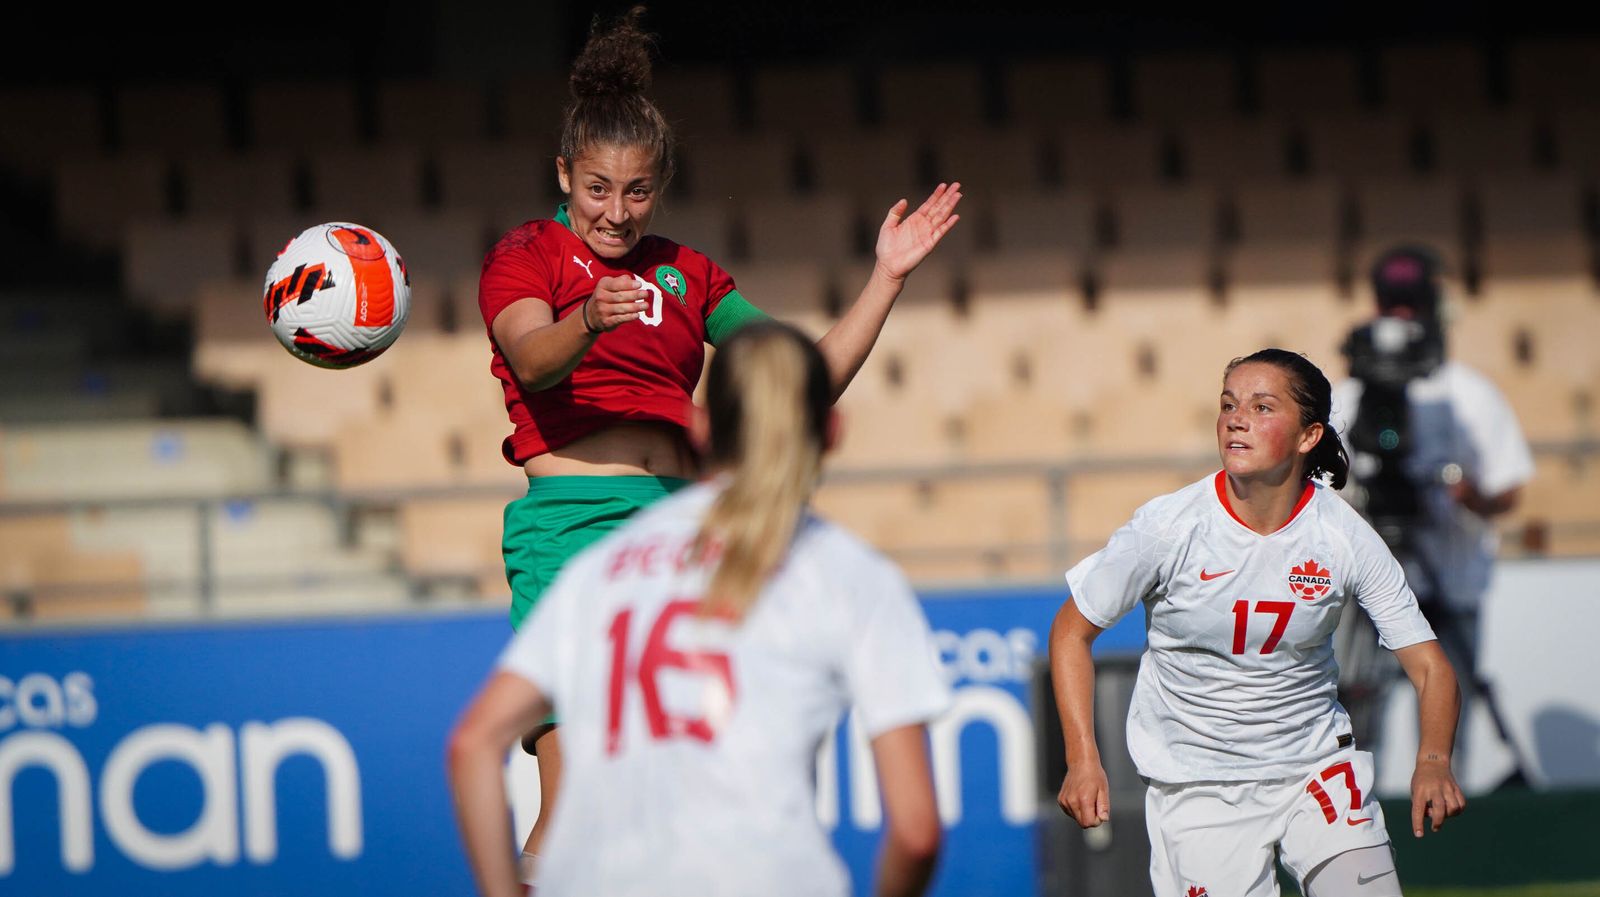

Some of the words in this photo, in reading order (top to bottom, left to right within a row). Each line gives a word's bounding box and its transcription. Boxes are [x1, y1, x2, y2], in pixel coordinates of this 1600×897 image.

[1288, 575, 1332, 585] CANADA
[1232, 600, 1296, 655] 17
[607, 599, 737, 756] 16
[1306, 761, 1362, 825] 17
